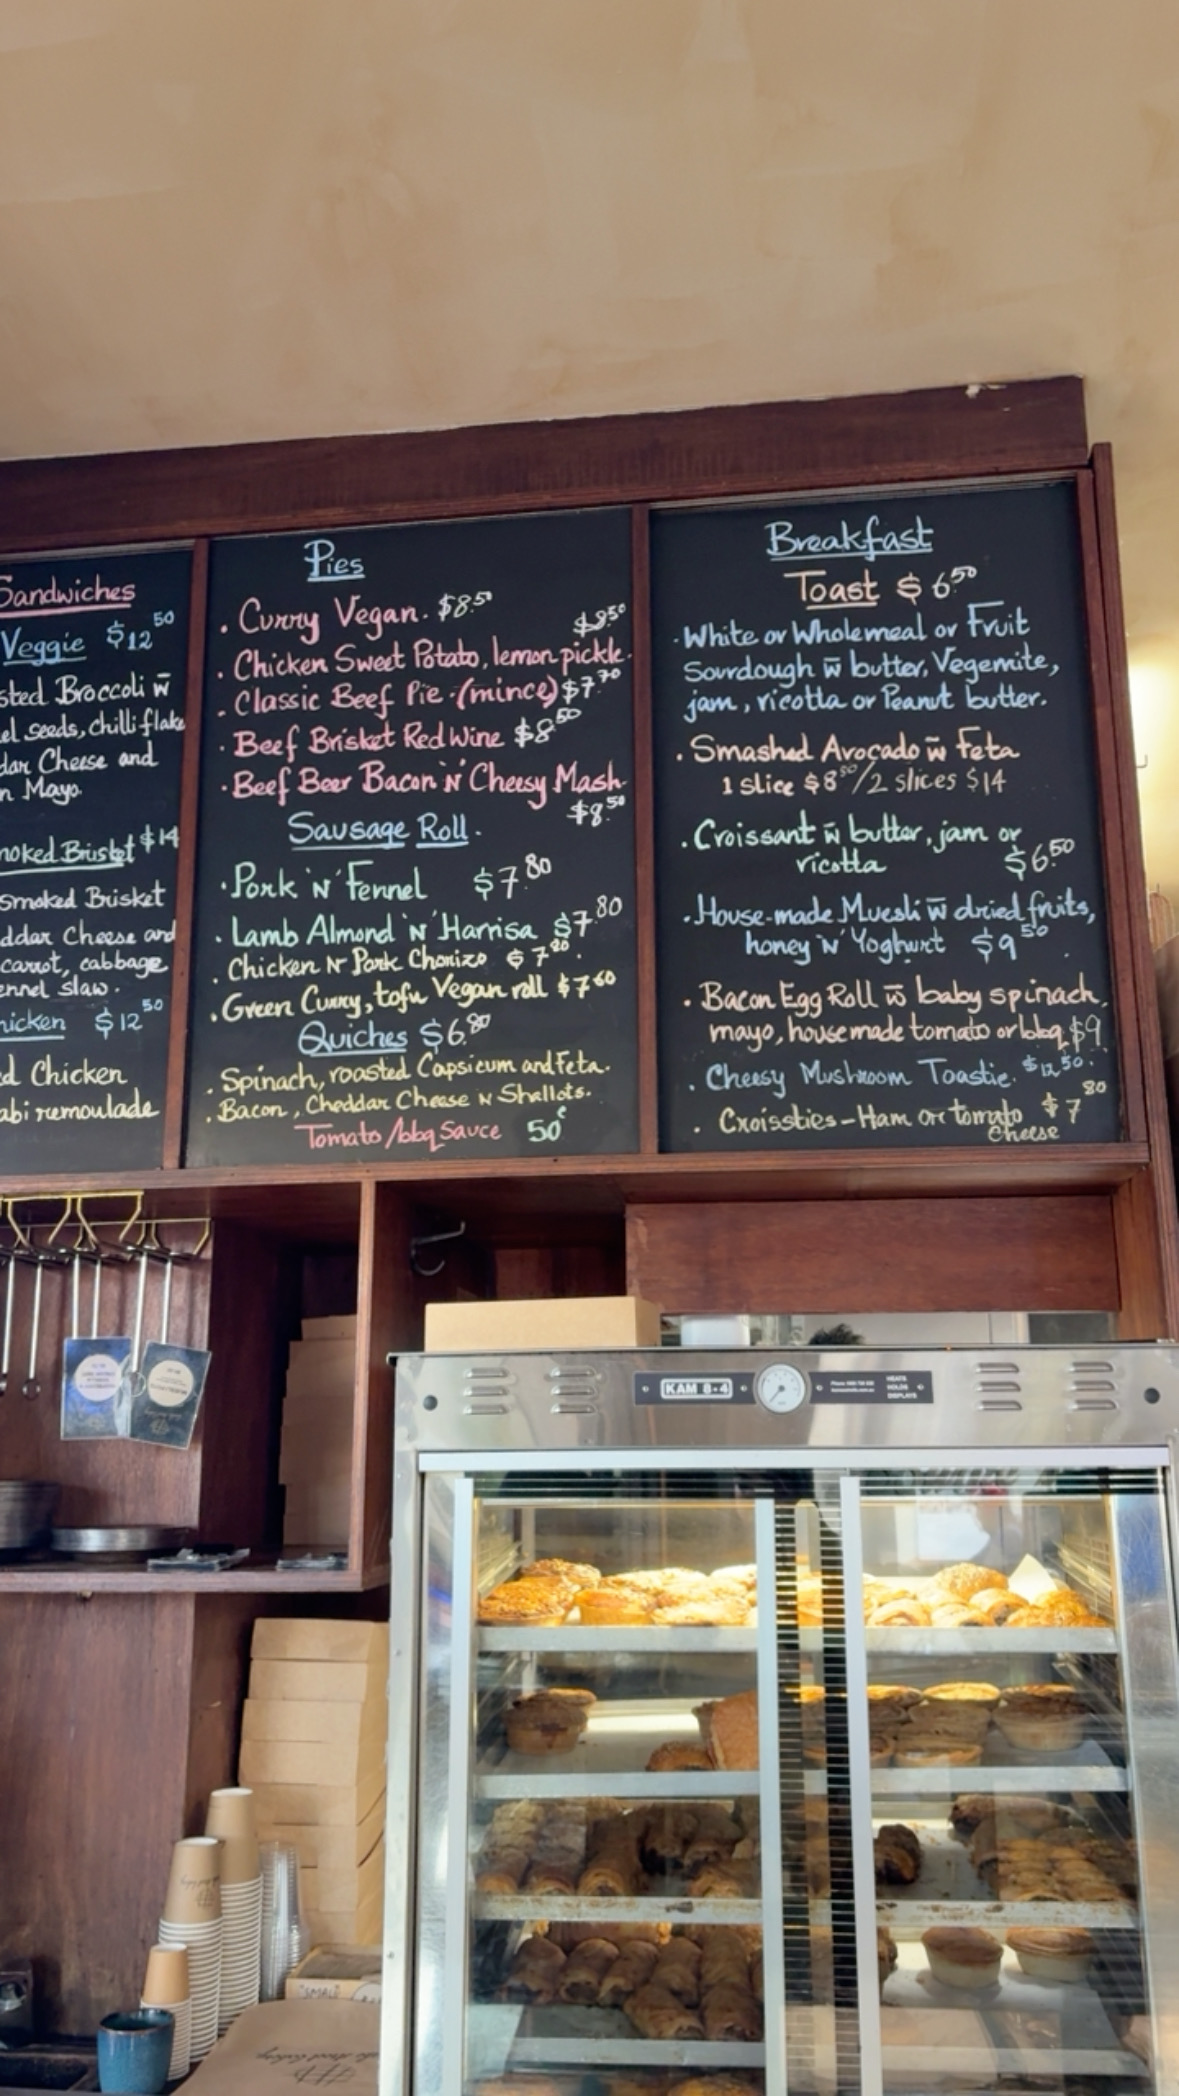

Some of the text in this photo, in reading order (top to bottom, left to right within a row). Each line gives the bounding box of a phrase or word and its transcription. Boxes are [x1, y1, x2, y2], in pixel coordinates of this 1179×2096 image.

[765, 516, 933, 561] Breakfast
[304, 539, 365, 577] Pies
[0, 573, 136, 608] Sandwiches
[784, 569, 880, 603] Toast
[238, 597, 320, 645] Curry
[683, 619, 759, 649] White
[763, 630, 788, 645] or
[934, 622, 957, 639] or
[966, 600, 1031, 639] Fruit
[1, 627, 86, 666] Veggie
[234, 648, 329, 681] Chicken
[334, 640, 406, 673] Sweet
[492, 635, 558, 665] lemon
[55, 671, 145, 705] Broccoli
[683, 652, 814, 689] Sourdough
[234, 684, 320, 716] Classic
[330, 682, 395, 719] Beef
[456, 675, 559, 710] (mince)
[756, 685, 848, 711] ricotta
[852, 694, 876, 710] or
[880, 682, 955, 711] Peanut
[24, 713, 86, 741] seeds,
[89, 708, 136, 736] chilli
[139, 707, 187, 737] flake
[233, 725, 300, 763] Beef
[309, 722, 396, 754] Brisket
[403, 721, 447, 749] Red
[449, 724, 506, 749] Wine
[38, 745, 108, 774] Cheese
[118, 740, 159, 767] and
[689, 726, 1021, 764] Smashed Avocado Feta
[231, 767, 292, 806] Beef
[298, 767, 352, 795] Beer
[358, 760, 438, 795] Bacon
[469, 761, 547, 810] Cheesy
[740, 773, 795, 796] slice
[895, 766, 957, 793] slices
[966, 767, 1007, 796] $14
[60, 834, 135, 863] Brisket
[140, 824, 180, 853] $14
[287, 811, 411, 848] Sausage
[693, 809, 816, 851] Croissant
[932, 821, 989, 853] jam
[998, 829, 1022, 845] or
[796, 846, 888, 876] ricotta
[84, 879, 166, 909] Brisket
[231, 861, 299, 899] Pork
[344, 860, 428, 901] Fennel
[835, 892, 921, 925] Muesli
[954, 891, 1023, 922] dried
[63, 919, 136, 946] Cheese
[143, 920, 176, 944] and
[232, 916, 300, 948] Lamb
[306, 914, 396, 945] Almond
[437, 915, 539, 942] Harrisa
[745, 930, 810, 965] honey
[79, 951, 168, 979] cabbage
[228, 953, 320, 982] Chicken
[352, 947, 404, 976] Pork
[408, 944, 487, 970] Chorizo
[221, 993, 295, 1023] Green
[373, 980, 429, 1015] tofu
[431, 975, 508, 1004] Vegan
[511, 974, 549, 1000] roll
[700, 980, 776, 1012] Bacon
[780, 981, 823, 1018] Egg
[826, 979, 879, 1008] Roll
[916, 974, 982, 1015] baby
[298, 1020, 408, 1056] Quiches
[909, 1011, 991, 1042] tomato
[31, 1054, 128, 1087] Chicken
[328, 1057, 411, 1083] roasted
[416, 1055, 514, 1087] Capsicum
[520, 1050, 555, 1075] and
[706, 1063, 786, 1099] Cheesy
[799, 1060, 912, 1087] Mushroom
[35, 1087, 160, 1121] remoulade
[305, 1093, 389, 1115] Cheddar
[396, 1086, 469, 1109] Cheese
[948, 1098, 1023, 1128] tomato
[666, 1383, 697, 1395] KAM
